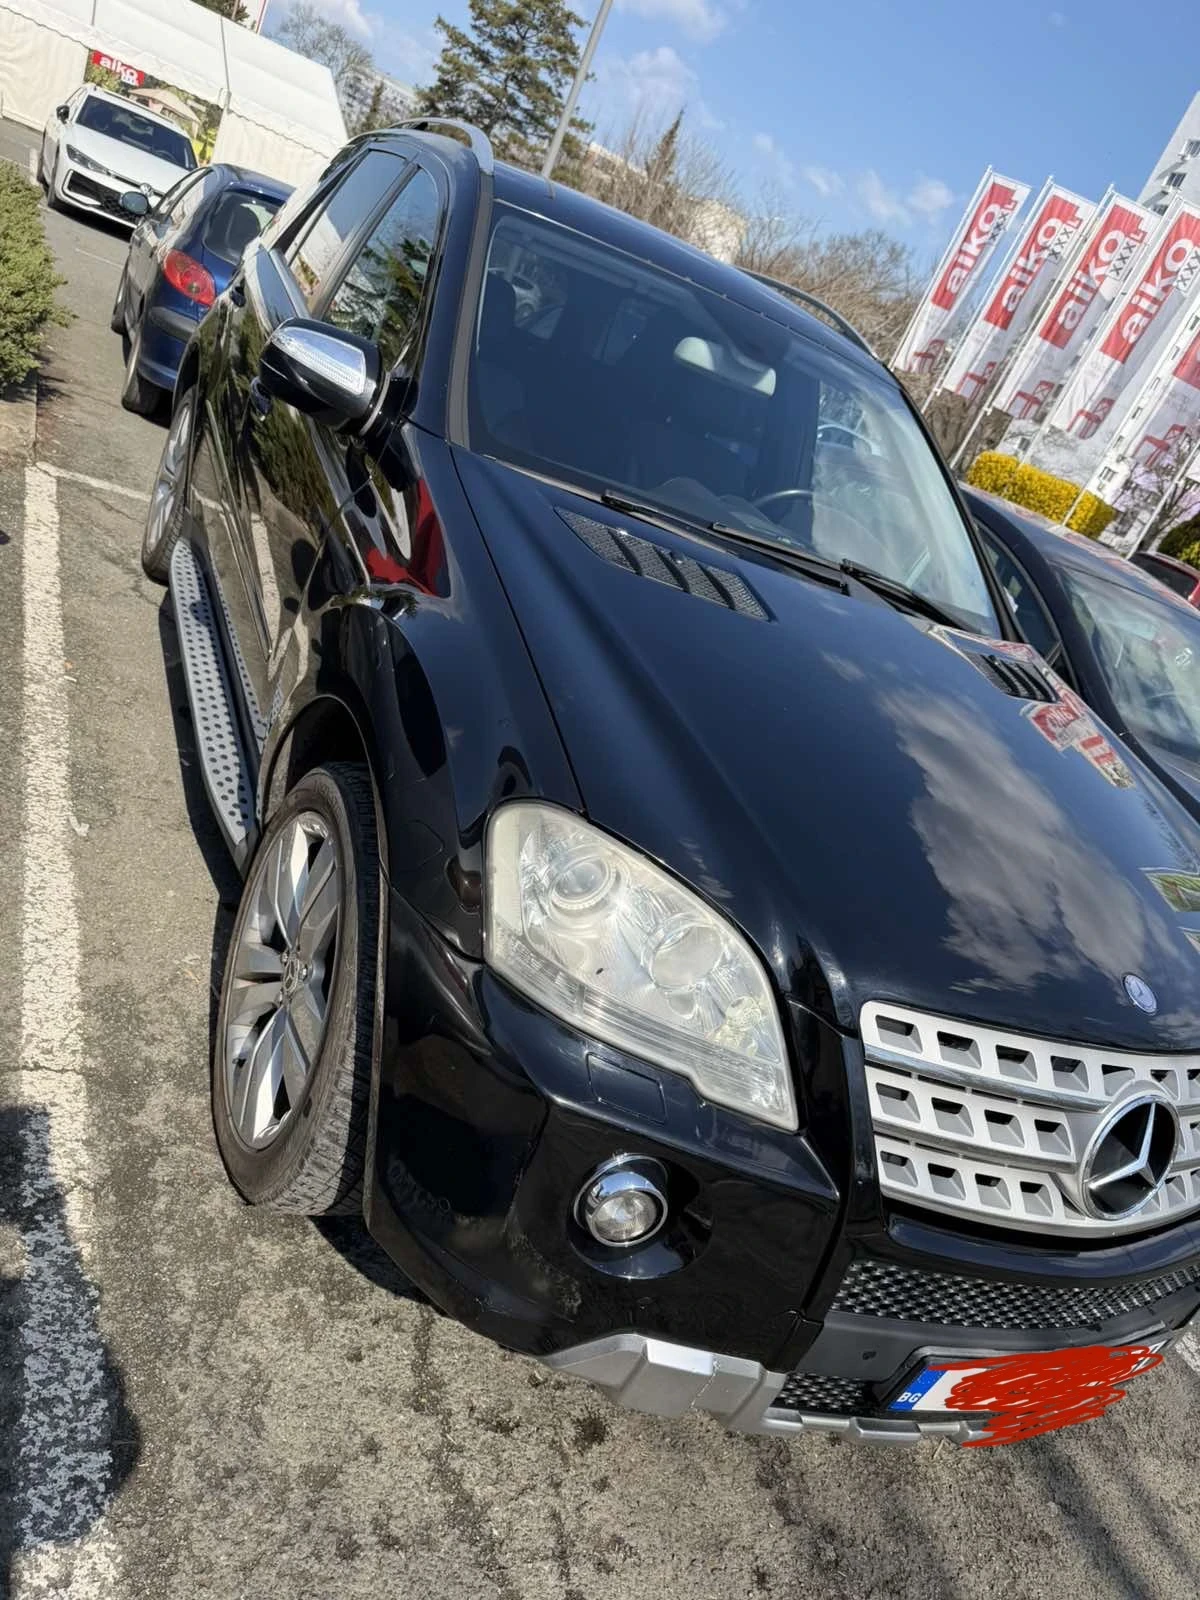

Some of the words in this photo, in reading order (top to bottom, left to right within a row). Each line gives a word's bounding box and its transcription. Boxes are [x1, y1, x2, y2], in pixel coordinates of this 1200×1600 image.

[99, 56, 138, 80] aiko
[946, 203, 1000, 294] aiko
[1002, 217, 1064, 313] aiko
[1058, 229, 1125, 330] aiko
[1110, 230, 1145, 276] XXXL
[1176, 250, 1200, 287] XXX
[1122, 238, 1193, 344] aiko
[896, 1391, 922, 1403] BG
